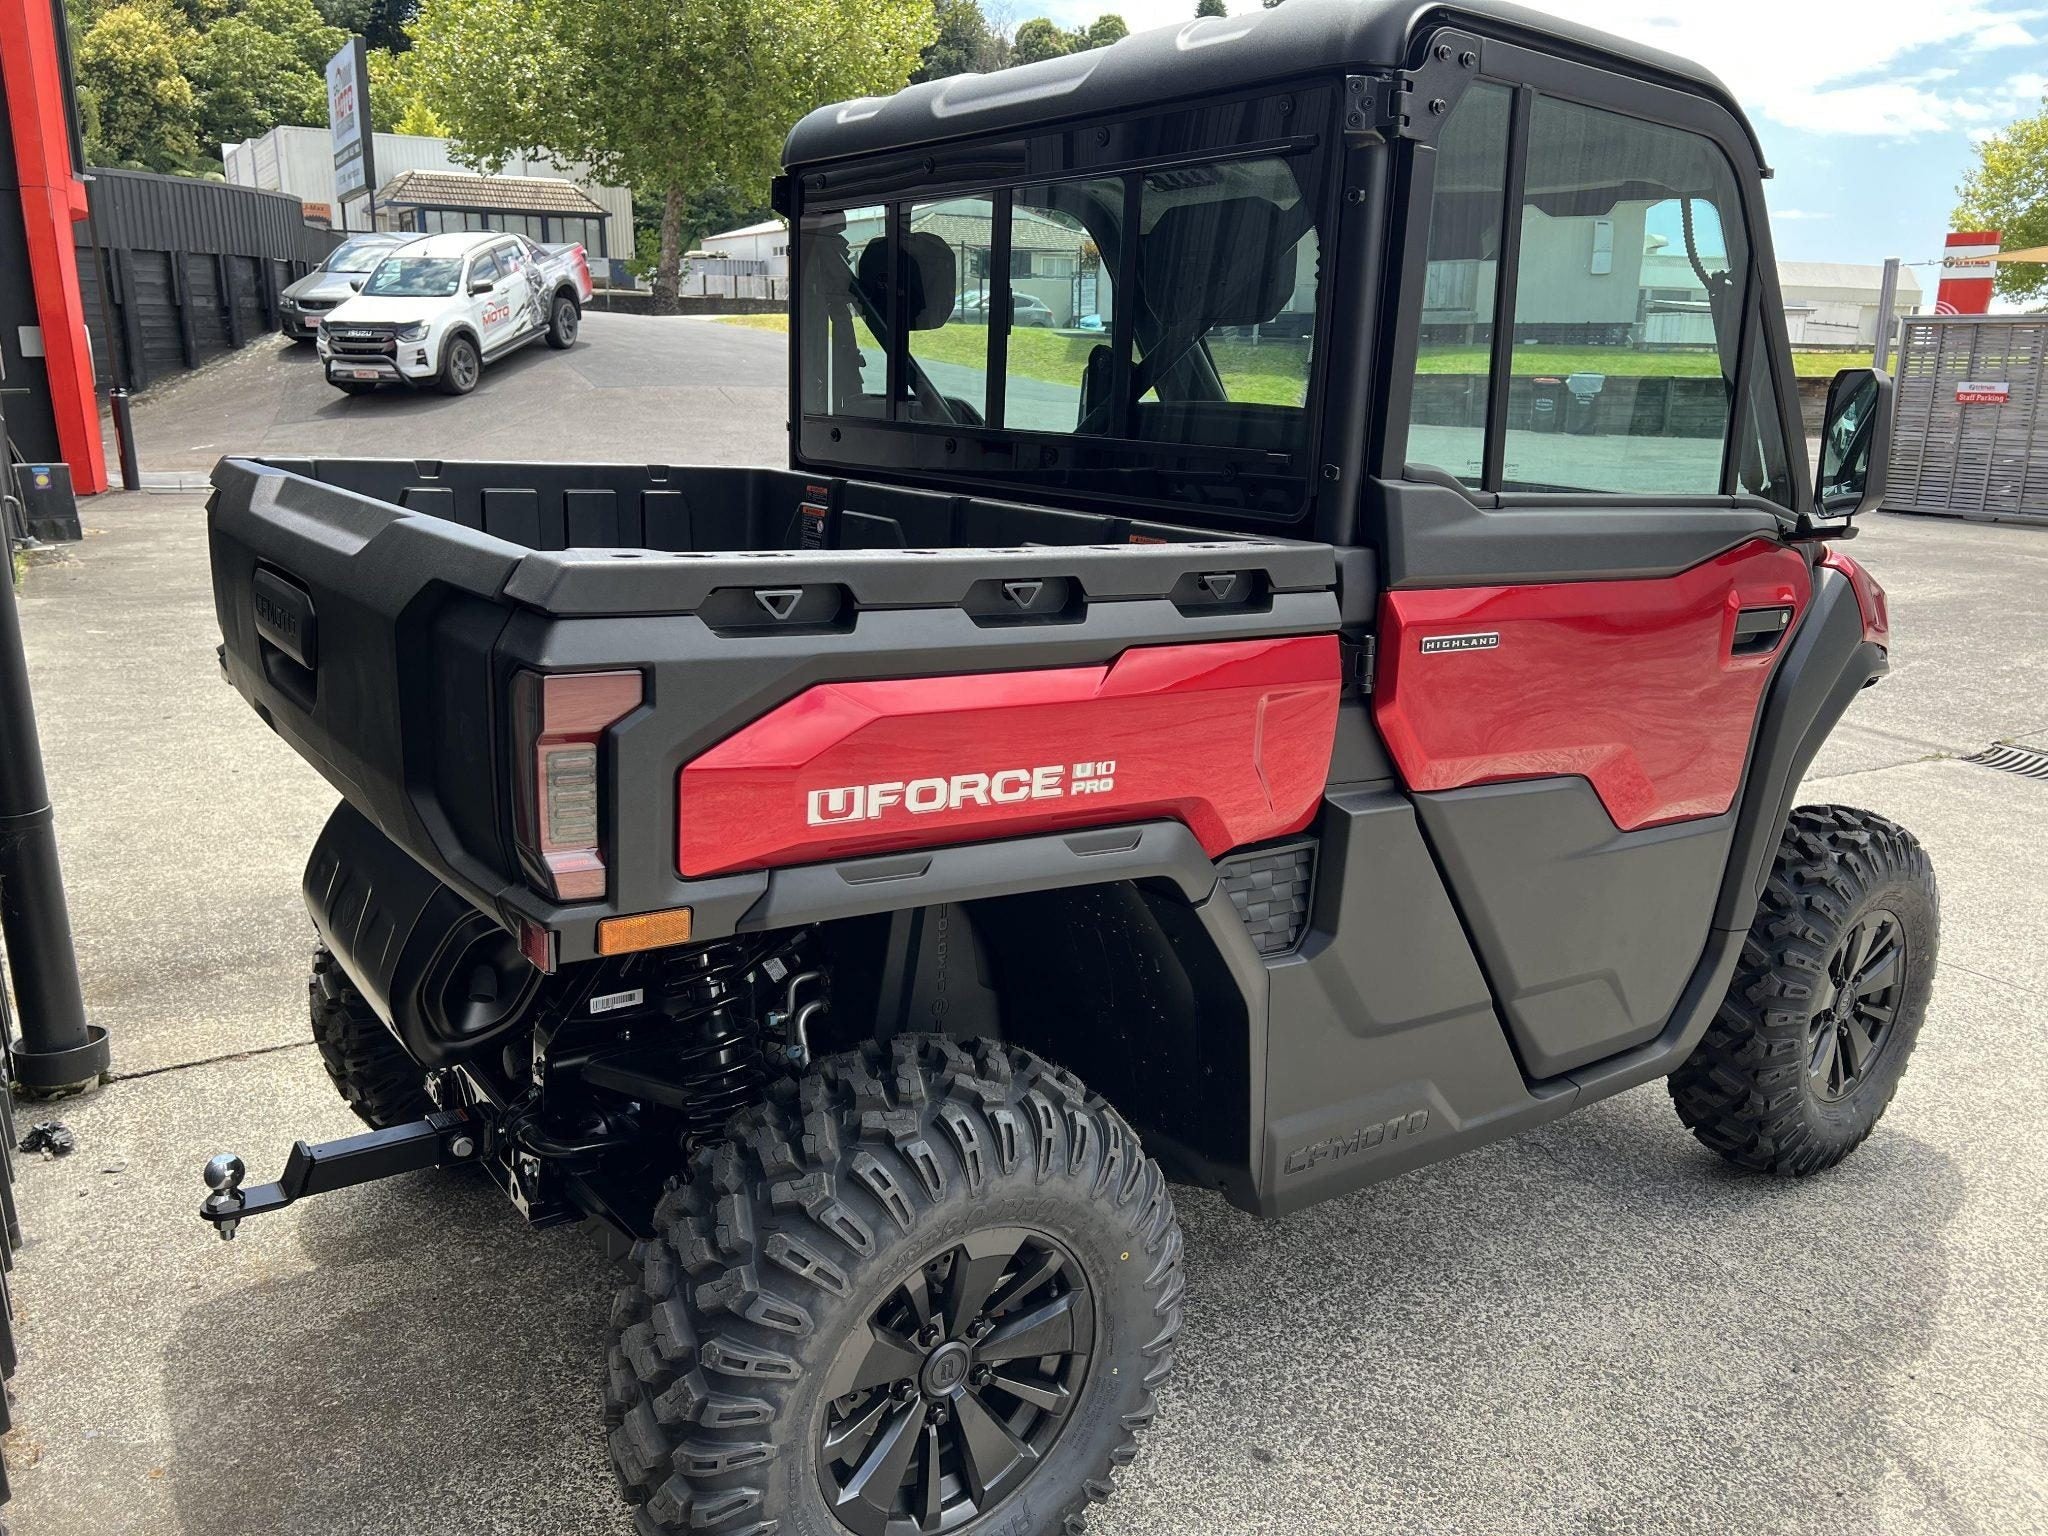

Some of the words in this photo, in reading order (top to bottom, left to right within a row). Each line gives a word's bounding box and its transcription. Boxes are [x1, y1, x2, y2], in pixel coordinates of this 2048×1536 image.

[482, 305, 510, 326] MOTO
[1959, 393, 1975, 401] Staff
[1976, 395, 2004, 403] Parking
[1426, 637, 1497, 650] HIGHLAND
[807, 765, 1064, 827] UFORCE
[1070, 778, 1114, 796] PRO
[1283, 1109, 1430, 1176] CFMOTO
